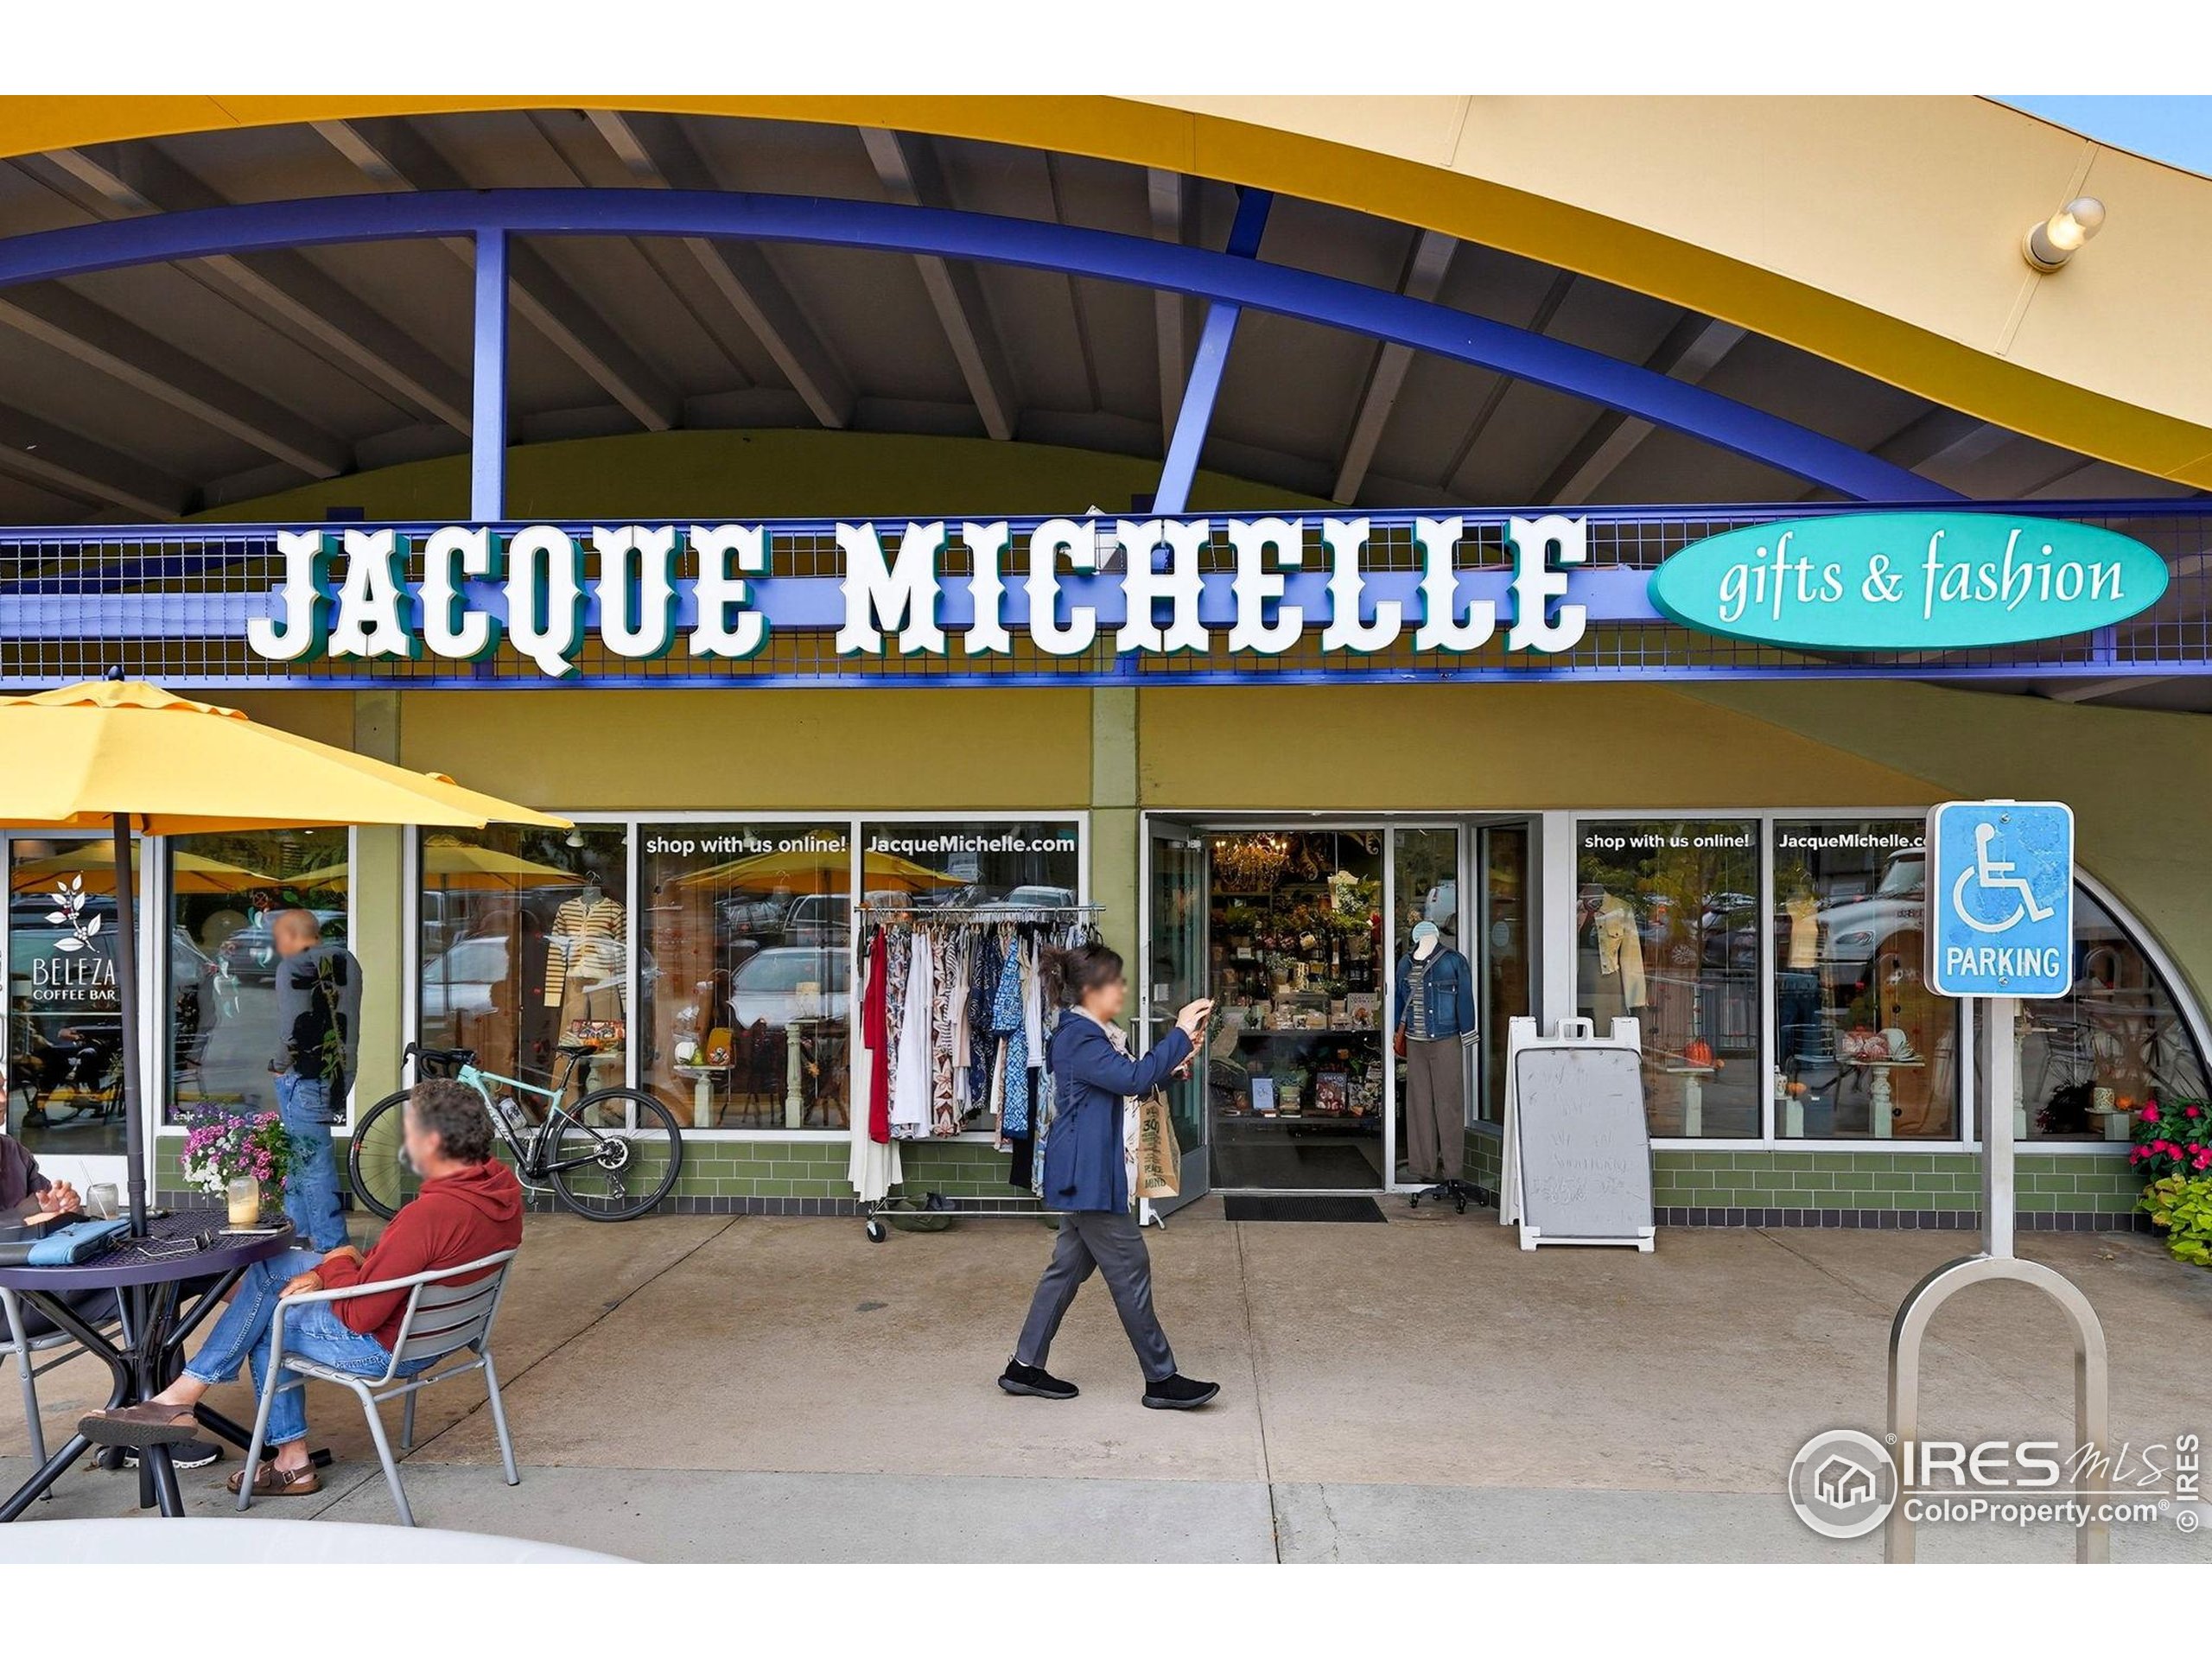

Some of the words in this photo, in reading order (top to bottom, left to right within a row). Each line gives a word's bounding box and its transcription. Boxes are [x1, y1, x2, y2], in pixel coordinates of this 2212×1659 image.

[1719, 531, 1844, 622] gifts
[1861, 553, 1904, 603] &
[1921, 529, 2126, 620] fashion
[247, 524, 769, 678] JACQUE
[836, 515, 1587, 655] MICHELLE
[646, 836, 695, 856] shop
[701, 836, 742, 853] with
[750, 840, 772, 853] us
[779, 836, 846, 853] online!
[868, 836, 1075, 855] JacqueMichelle.com
[1585, 835, 1625, 850] shop
[1630, 835, 1664, 848] with
[1669, 837, 1689, 848] us
[1694, 834, 1749, 848] online!
[1779, 834, 1926, 851] JacqueMichelle.c
[33, 957, 116, 985] BELEZA
[1947, 946, 2060, 978] PARKING
[33, 989, 85, 1001] COFFEE
[90, 989, 116, 1001] BAR
